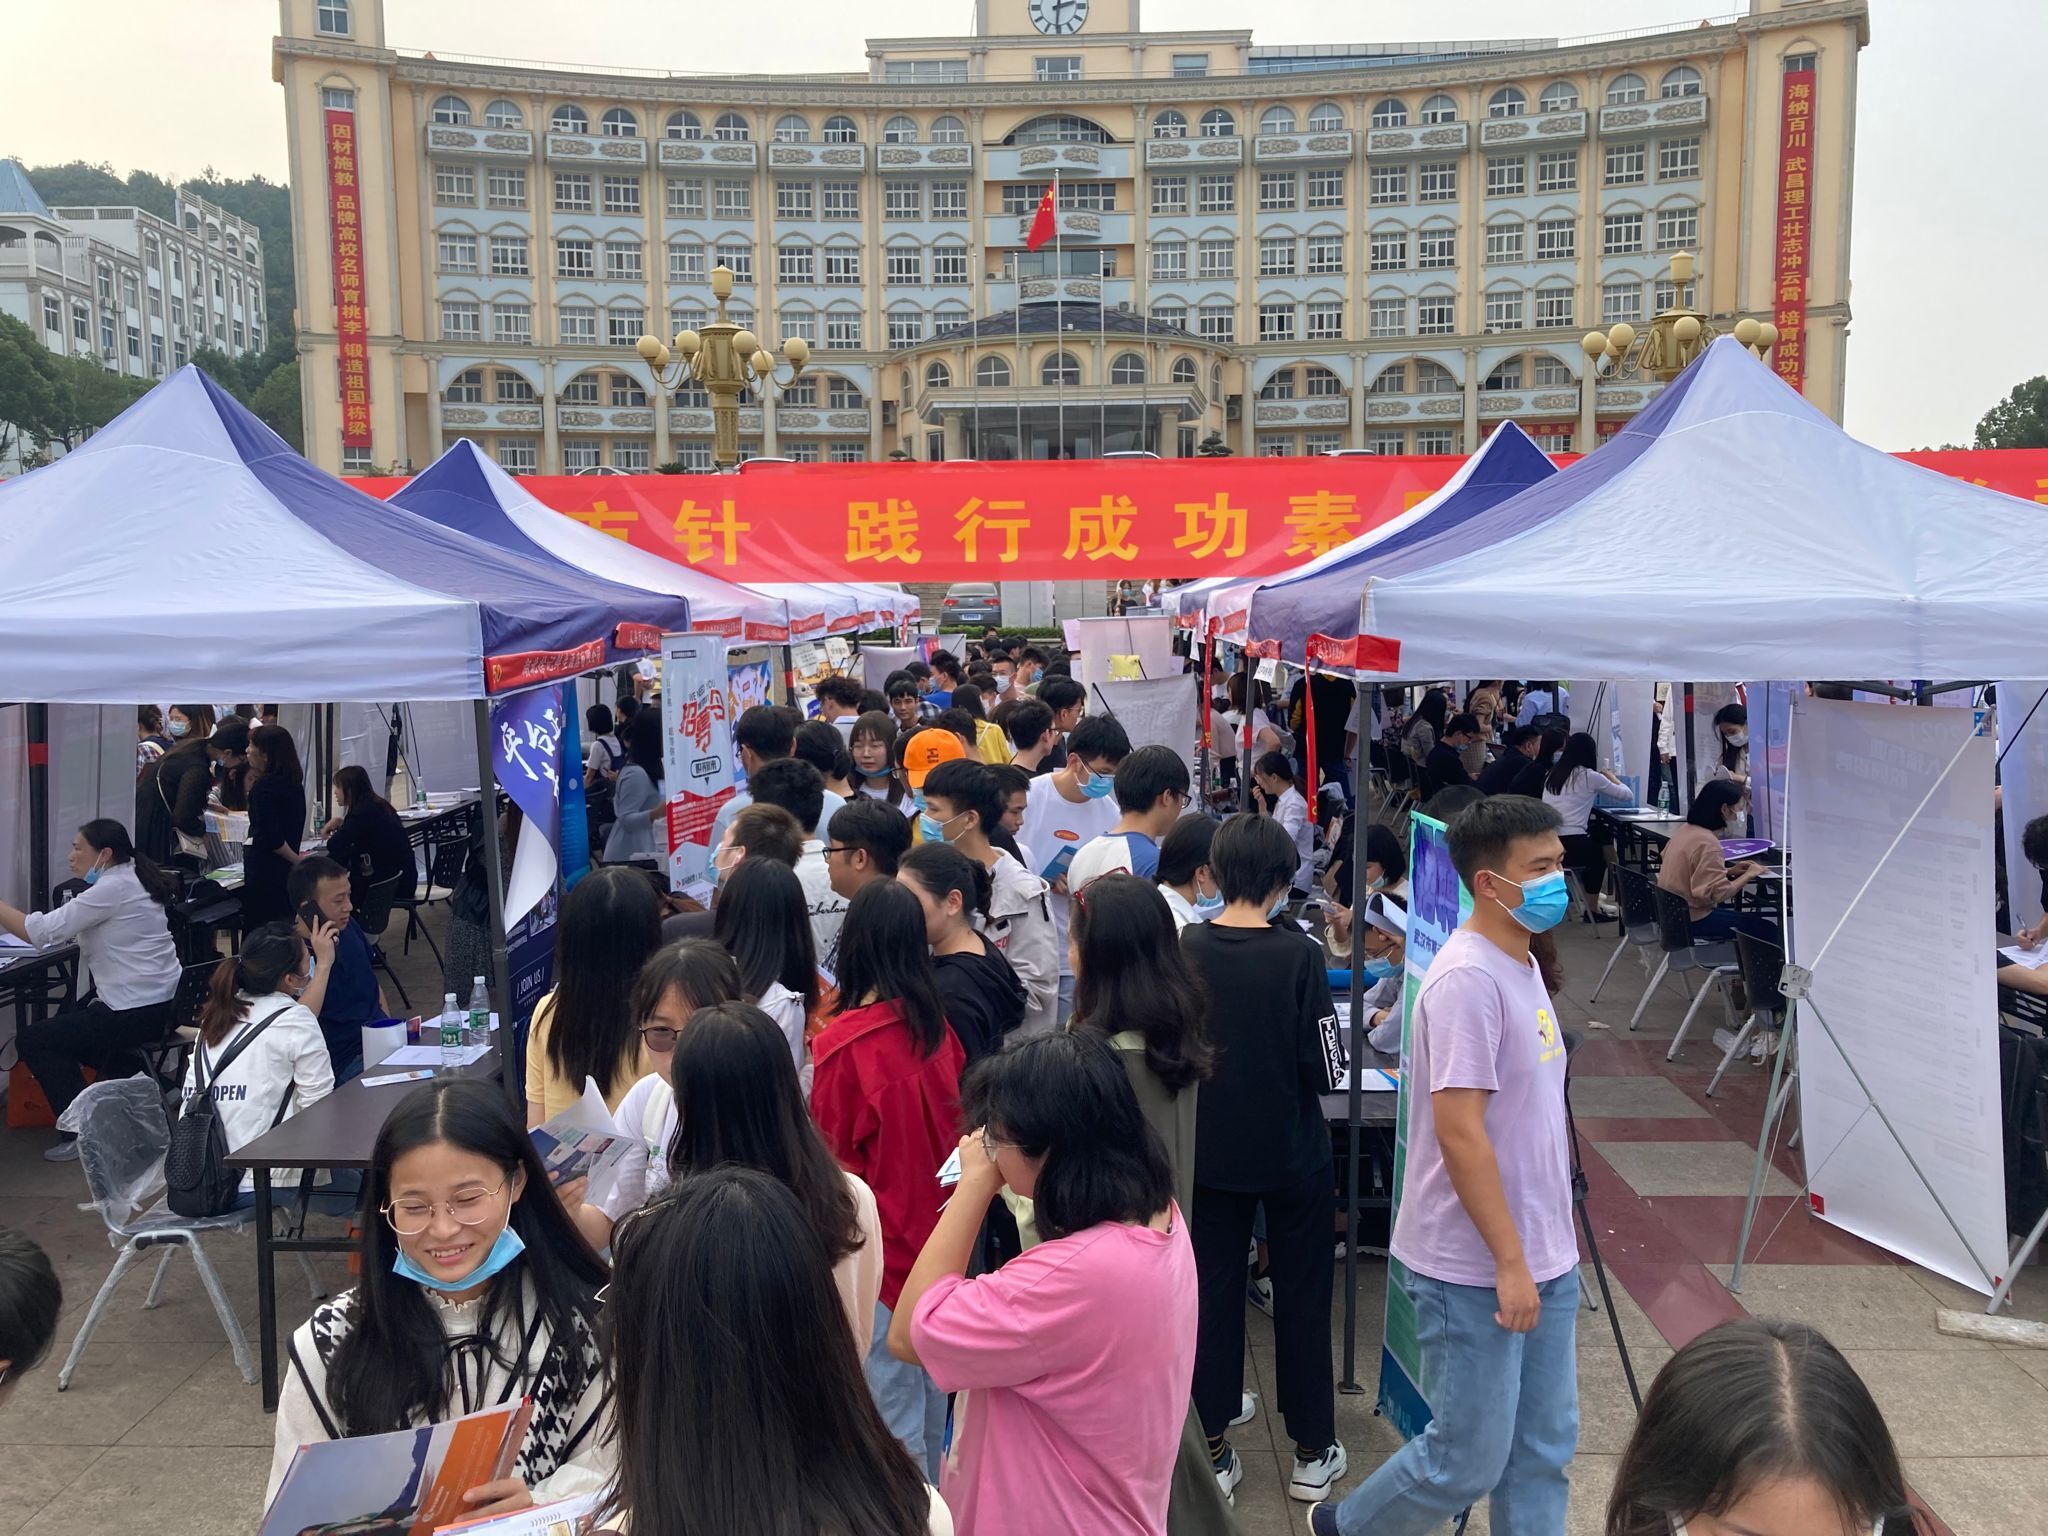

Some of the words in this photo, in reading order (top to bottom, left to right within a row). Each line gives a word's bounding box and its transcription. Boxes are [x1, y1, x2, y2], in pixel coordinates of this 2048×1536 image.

[332, 124, 354, 187] 因材施教
[1787, 84, 1810, 148] 海纳百川
[337, 195, 362, 335] 品牌高校名师育桃李
[1781, 158, 1807, 302] 武昌理工壮志冲云霄
[344, 343, 367, 435] 锻造祖国栋梁
[845, 490, 1436, 565] 践行成功素
